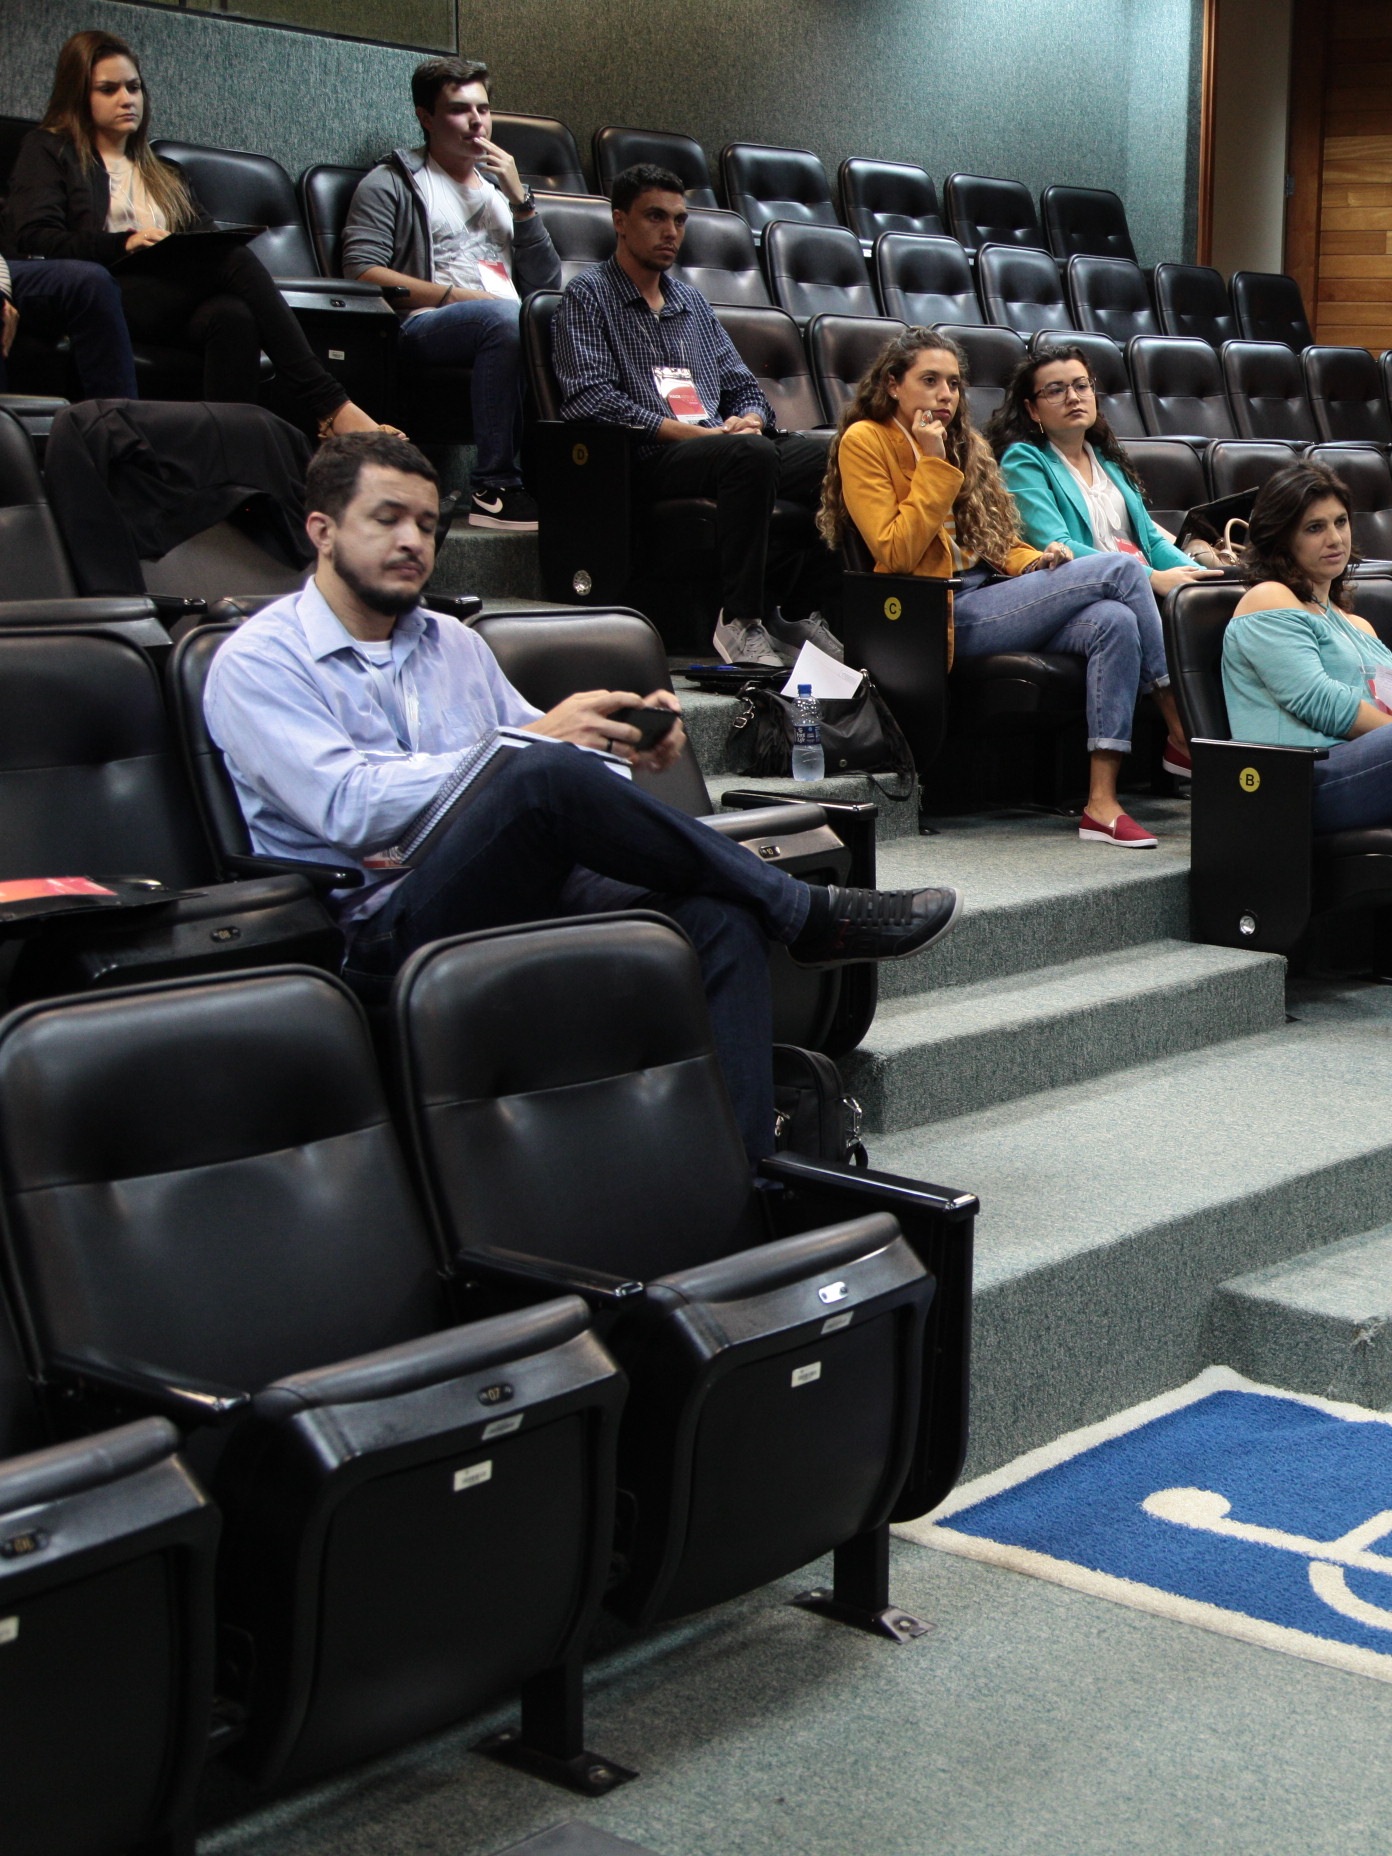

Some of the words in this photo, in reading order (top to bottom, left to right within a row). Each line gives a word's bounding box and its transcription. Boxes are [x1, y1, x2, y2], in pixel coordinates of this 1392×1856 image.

[889, 603, 897, 614] C
[1246, 774, 1255, 786] B
[488, 1387, 500, 1401] 07
